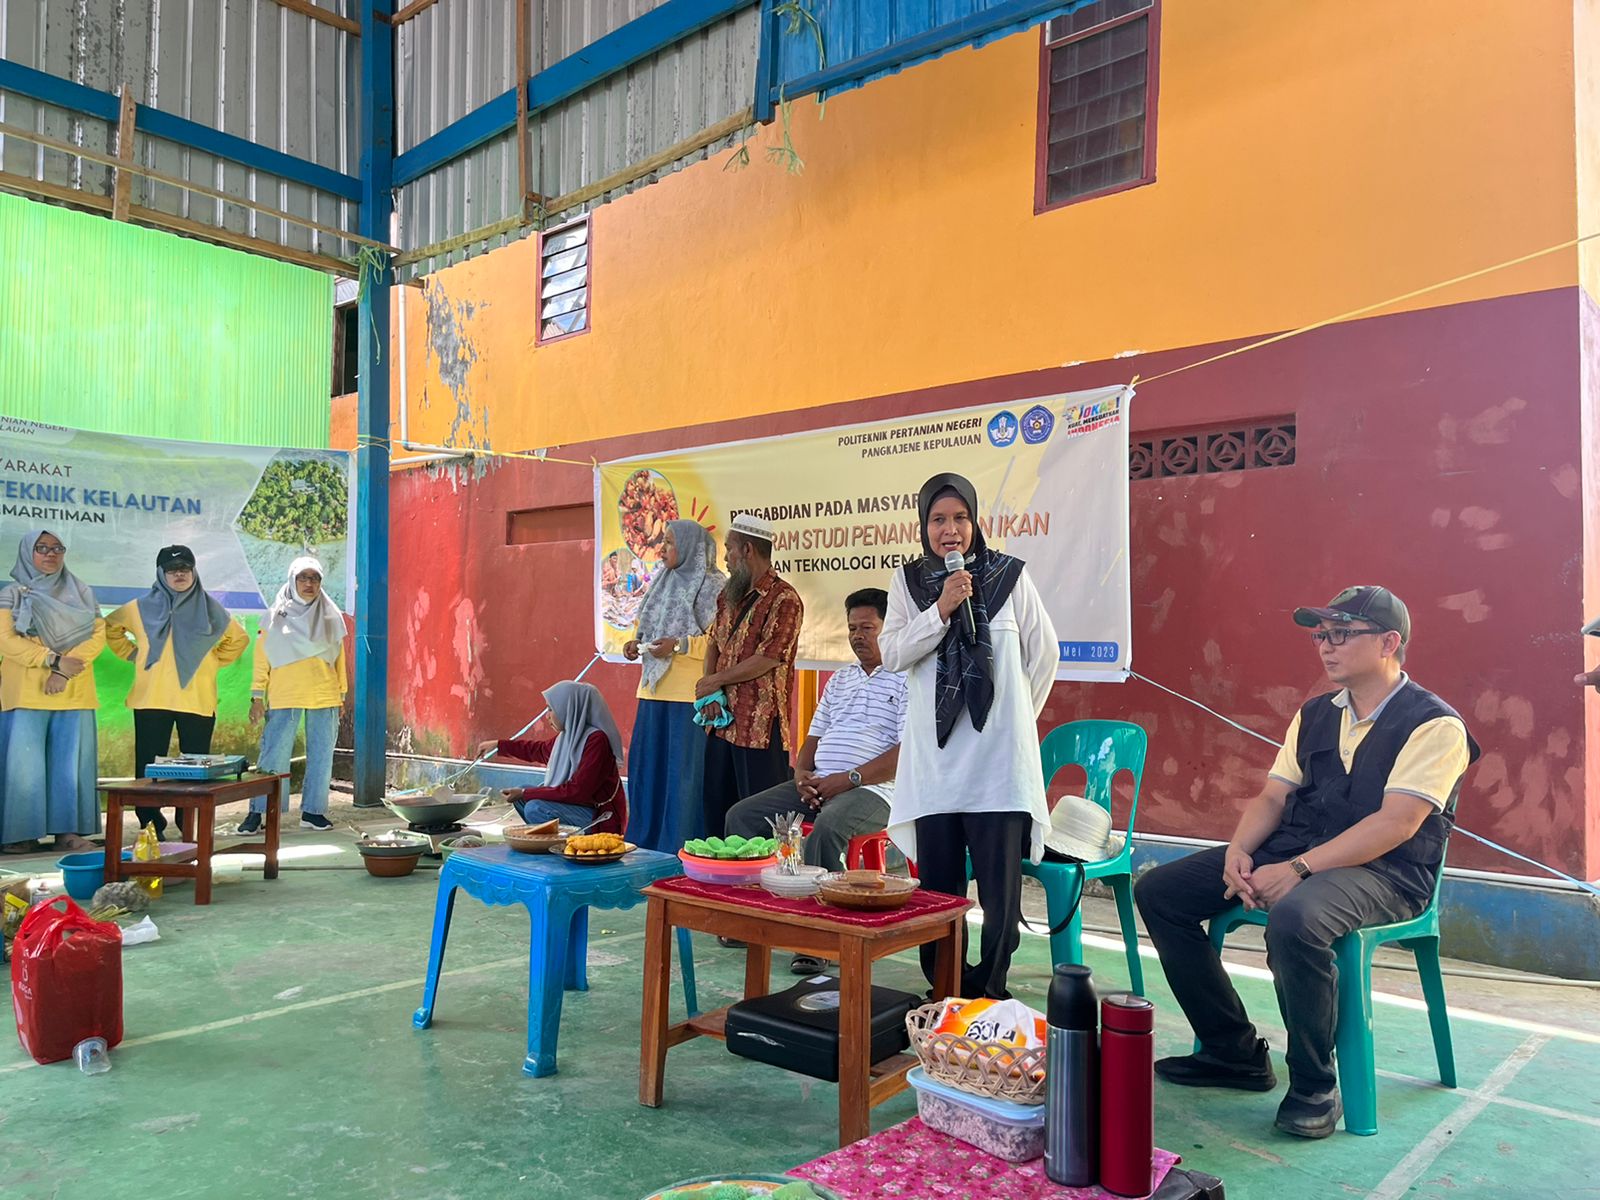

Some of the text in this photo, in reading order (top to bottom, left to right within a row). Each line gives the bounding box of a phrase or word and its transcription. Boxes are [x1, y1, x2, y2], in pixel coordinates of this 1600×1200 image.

[0, 416, 28, 427] NIAN
[0, 424, 36, 436] LAUAN
[838, 417, 982, 447] POLITEKNIK PERTANIAN NEGERI
[861, 433, 982, 459] PANGKAJENE KEPULAUAN
[0, 457, 73, 478] ARAKAT
[83, 488, 201, 515] KELAUTAN
[815, 500, 853, 518] PADA
[0, 503, 106, 524] MARITIMAN
[771, 530, 800, 552] RAM
[802, 526, 849, 550] STUDI
[997, 511, 1050, 538] IKAN
[769, 560, 791, 574] AN
[794, 555, 876, 573] TEKNOLOGI
[1063, 645, 1115, 658] Mei 2023
